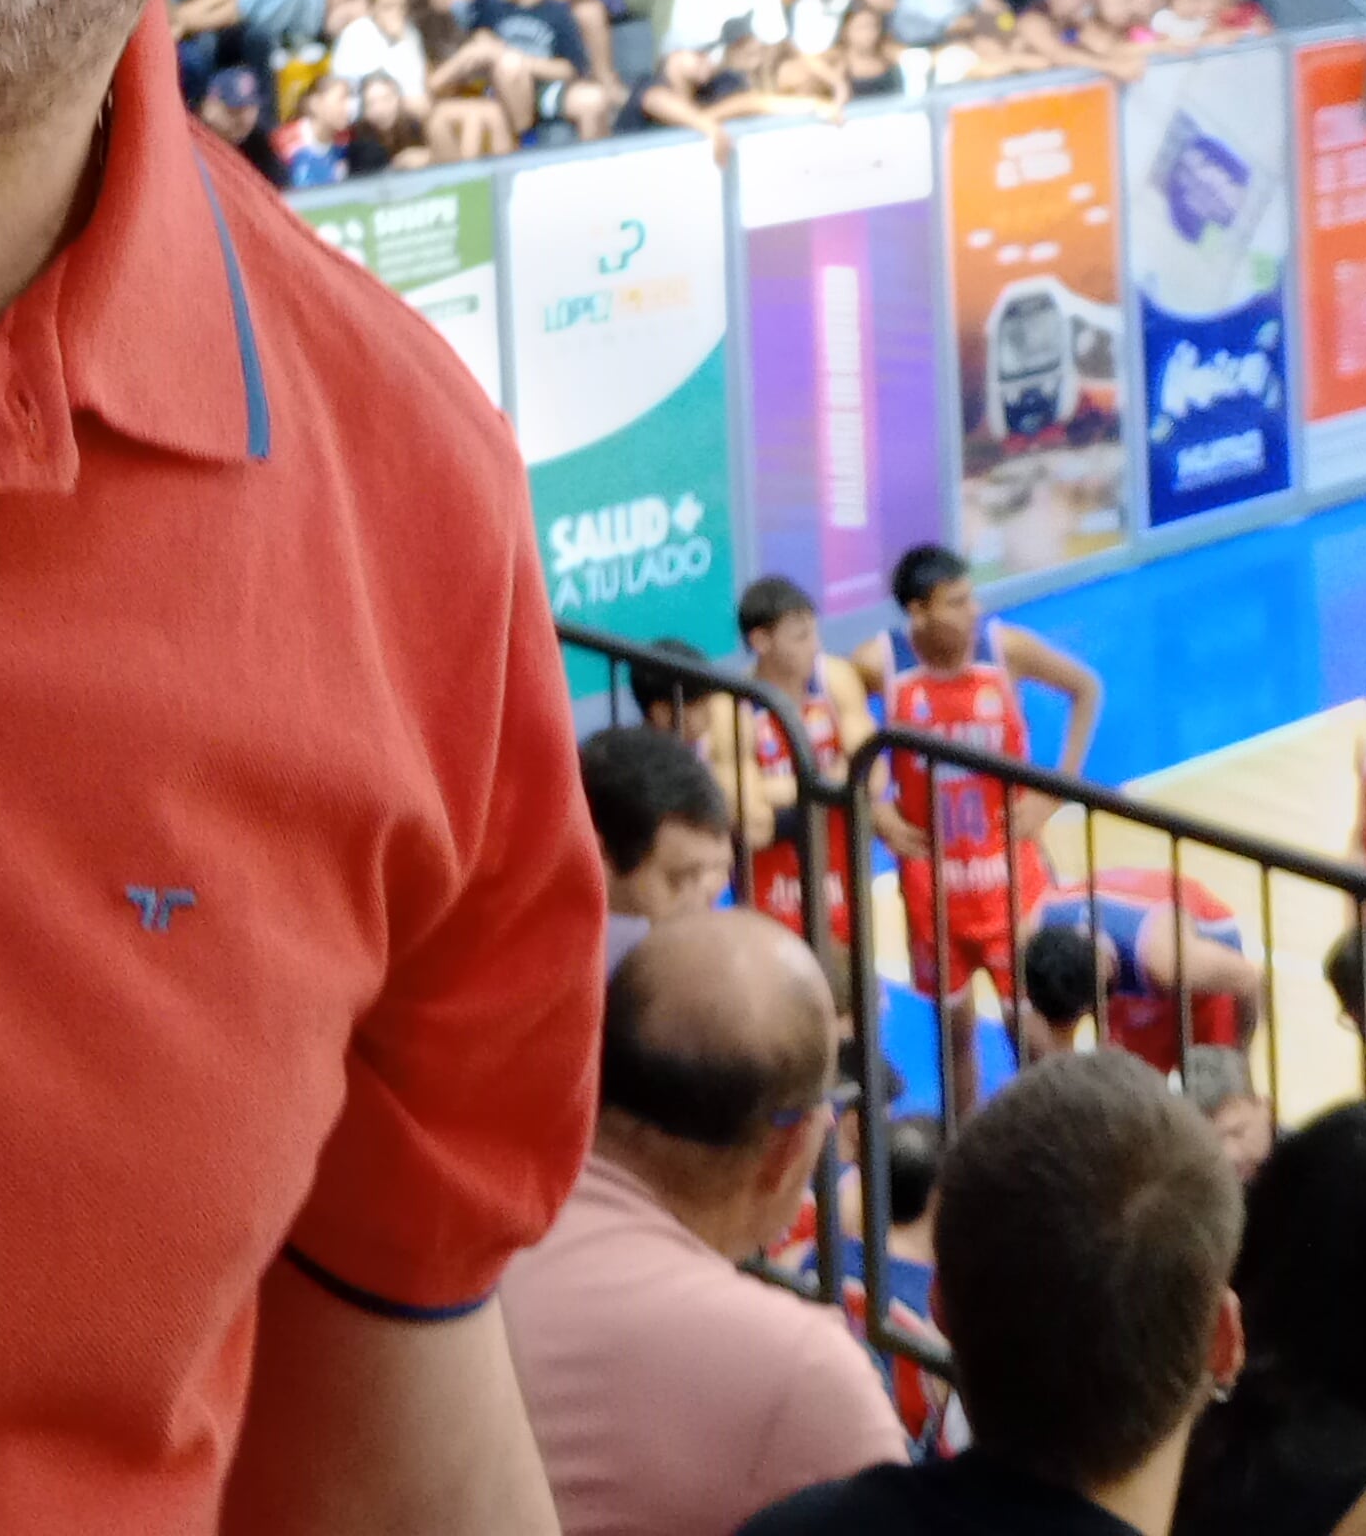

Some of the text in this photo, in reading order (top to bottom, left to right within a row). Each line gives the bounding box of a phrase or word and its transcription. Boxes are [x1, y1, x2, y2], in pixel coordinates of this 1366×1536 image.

[552, 535, 713, 616] A TU LADO
